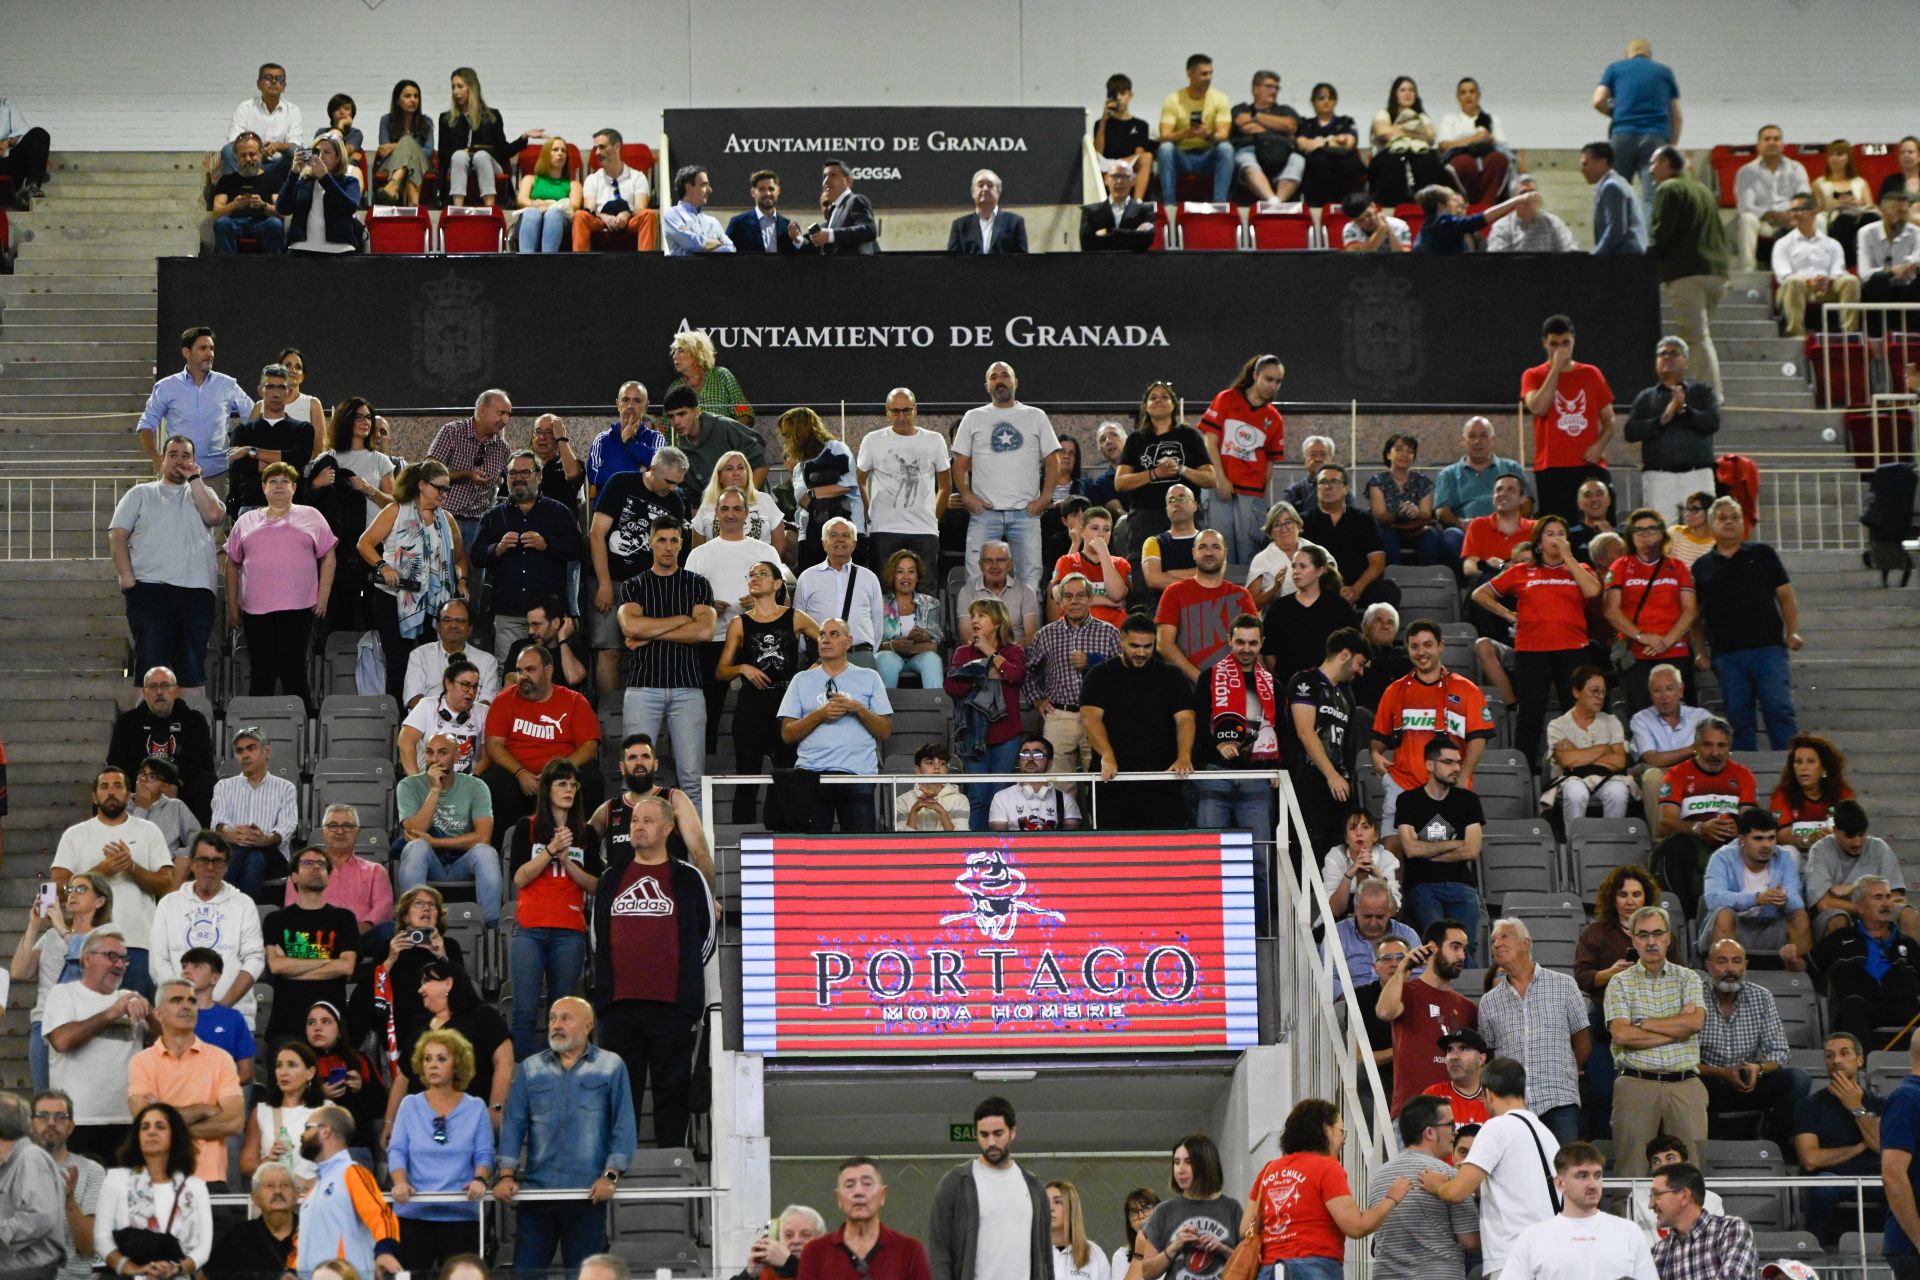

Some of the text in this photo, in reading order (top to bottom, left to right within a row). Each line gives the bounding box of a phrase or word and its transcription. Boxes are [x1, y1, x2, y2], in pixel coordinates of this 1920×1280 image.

[724, 131, 1027, 153] AYUNTAMIENTO DE GRANADA
[950, 326, 994, 347] DE
[1005, 315, 1170, 347] GRANADA
[513, 718, 555, 740] PUMA
[1217, 730, 1239, 739] acb
[616, 899, 667, 911] adidas
[811, 945, 1197, 1006] PORTAGO
[883, 1003, 1126, 1021] MODA HOMBRE
